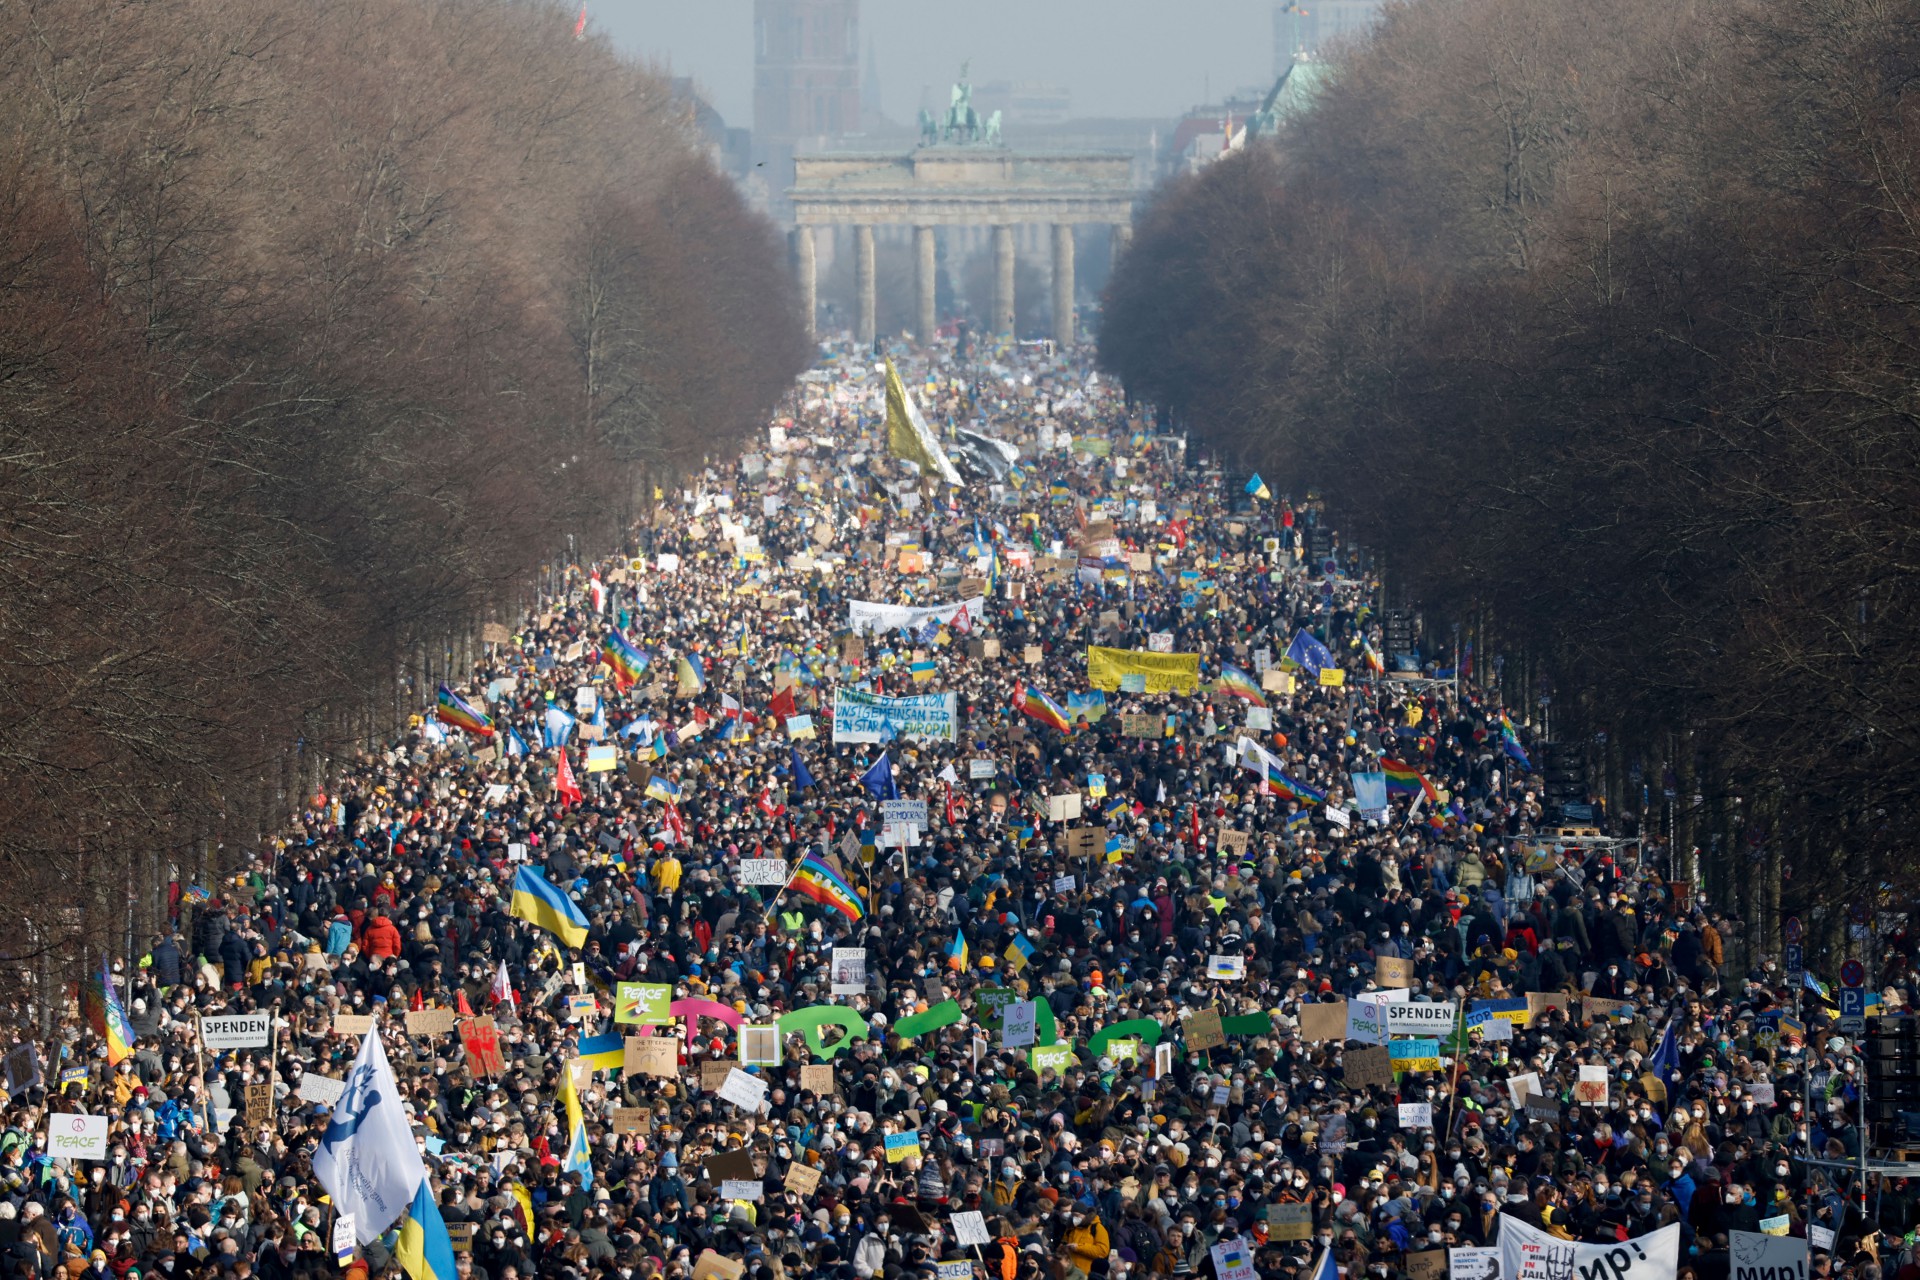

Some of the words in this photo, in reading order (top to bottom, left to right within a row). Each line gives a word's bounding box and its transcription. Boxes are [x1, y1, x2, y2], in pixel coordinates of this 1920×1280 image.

[924, 695, 947, 708] VON
[862, 707, 926, 721] GEMEINSAM
[836, 719, 853, 733] EIN
[854, 720, 900, 733] STARS
[903, 722, 951, 738] EUROPA!
[885, 810, 928, 820] DEMOCRACY
[1222, 832, 1245, 843] ПУТИН
[744, 859, 767, 872] STOP
[768, 859, 783, 872] HIS
[744, 871, 771, 884] WAR
[812, 871, 851, 904] PACE
[836, 949, 864, 958] RESPEKT
[622, 986, 667, 1000] PEACE
[980, 992, 1012, 1004] PEACE
[1844, 990, 1858, 1012] P
[1389, 1006, 1451, 1020] SPENDEN
[205, 1019, 266, 1034] SPENDEN
[1008, 1021, 1030, 1036] PEACE
[1115, 1043, 1140, 1057] PEACE
[1391, 1042, 1413, 1057] STOP
[1414, 1042, 1439, 1057] PUTIN
[1036, 1051, 1068, 1067] PEACE
[1392, 1059, 1417, 1072] STOP
[1418, 1057, 1438, 1070] WAR
[64, 1068, 86, 1079] STAND
[805, 1066, 828, 1080] STOP
[251, 1085, 267, 1098] DIE
[809, 1080, 828, 1093] WAR
[1400, 1106, 1416, 1114] FUCK
[1418, 1106, 1429, 1114] YOU
[1406, 1114, 1428, 1123] PUTIN!
[55, 1134, 100, 1149] PEACE
[887, 1134, 904, 1144] STOP
[1319, 1141, 1346, 1149] UKRAINE
[888, 1147, 905, 1157] STOP
[952, 1211, 982, 1229] STOP
[1763, 1216, 1788, 1229] PEACE
[959, 1227, 987, 1244] WAR
[1219, 1240, 1243, 1255] STOP
[1521, 1244, 1541, 1253] PUT
[1529, 1254, 1546, 1262] HIM
[938, 1263, 960, 1279] EACE
[1410, 1261, 1433, 1273] STOP
[1524, 1261, 1536, 1269] IN
[1220, 1270, 1233, 1280] THE
[1234, 1266, 1251, 1279] WAR
[1521, 1269, 1546, 1280] JAIL
